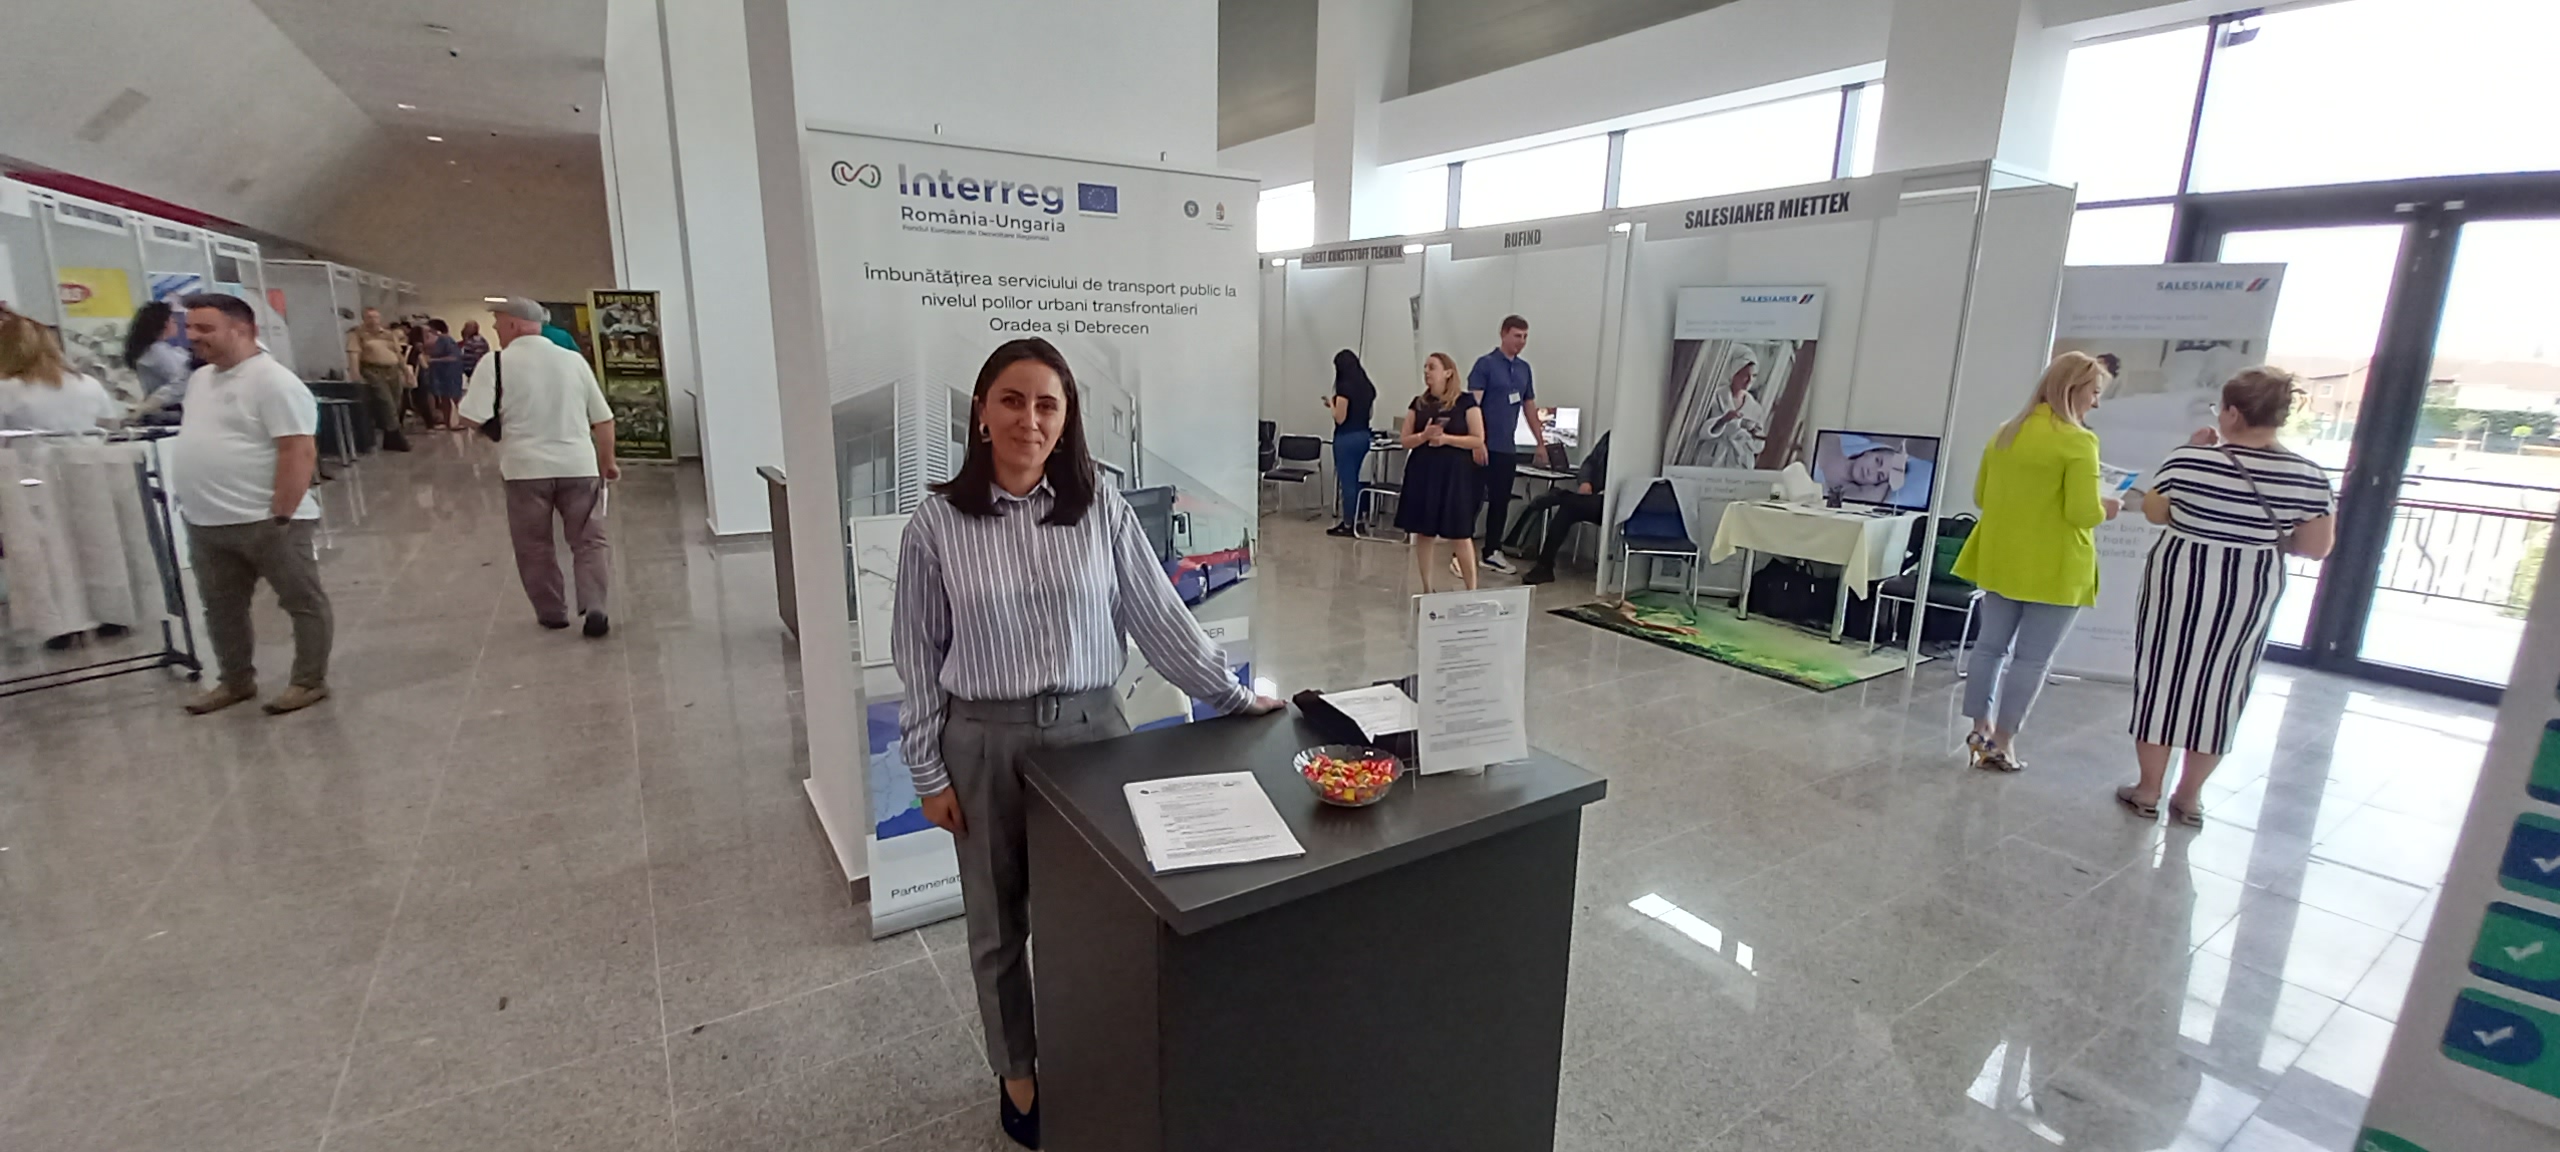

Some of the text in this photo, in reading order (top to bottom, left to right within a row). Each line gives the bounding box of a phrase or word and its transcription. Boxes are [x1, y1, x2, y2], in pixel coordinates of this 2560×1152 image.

[898, 163, 1064, 215] Interreg
[901, 205, 1066, 234] România-Ungaria
[1685, 191, 1851, 230] SALESIANER MIETTEX
[998, 275, 1078, 290] serviciului
[1082, 277, 1103, 292] de
[1107, 279, 1177, 296] transport
[1180, 283, 1222, 298] public
[1225, 284, 1237, 298] la
[2156, 280, 2244, 291] SALESIANER
[921, 293, 1198, 316] nivelul polilor urbani transfrontalieri
[989, 317, 1149, 335] Oradea și Debrecen
